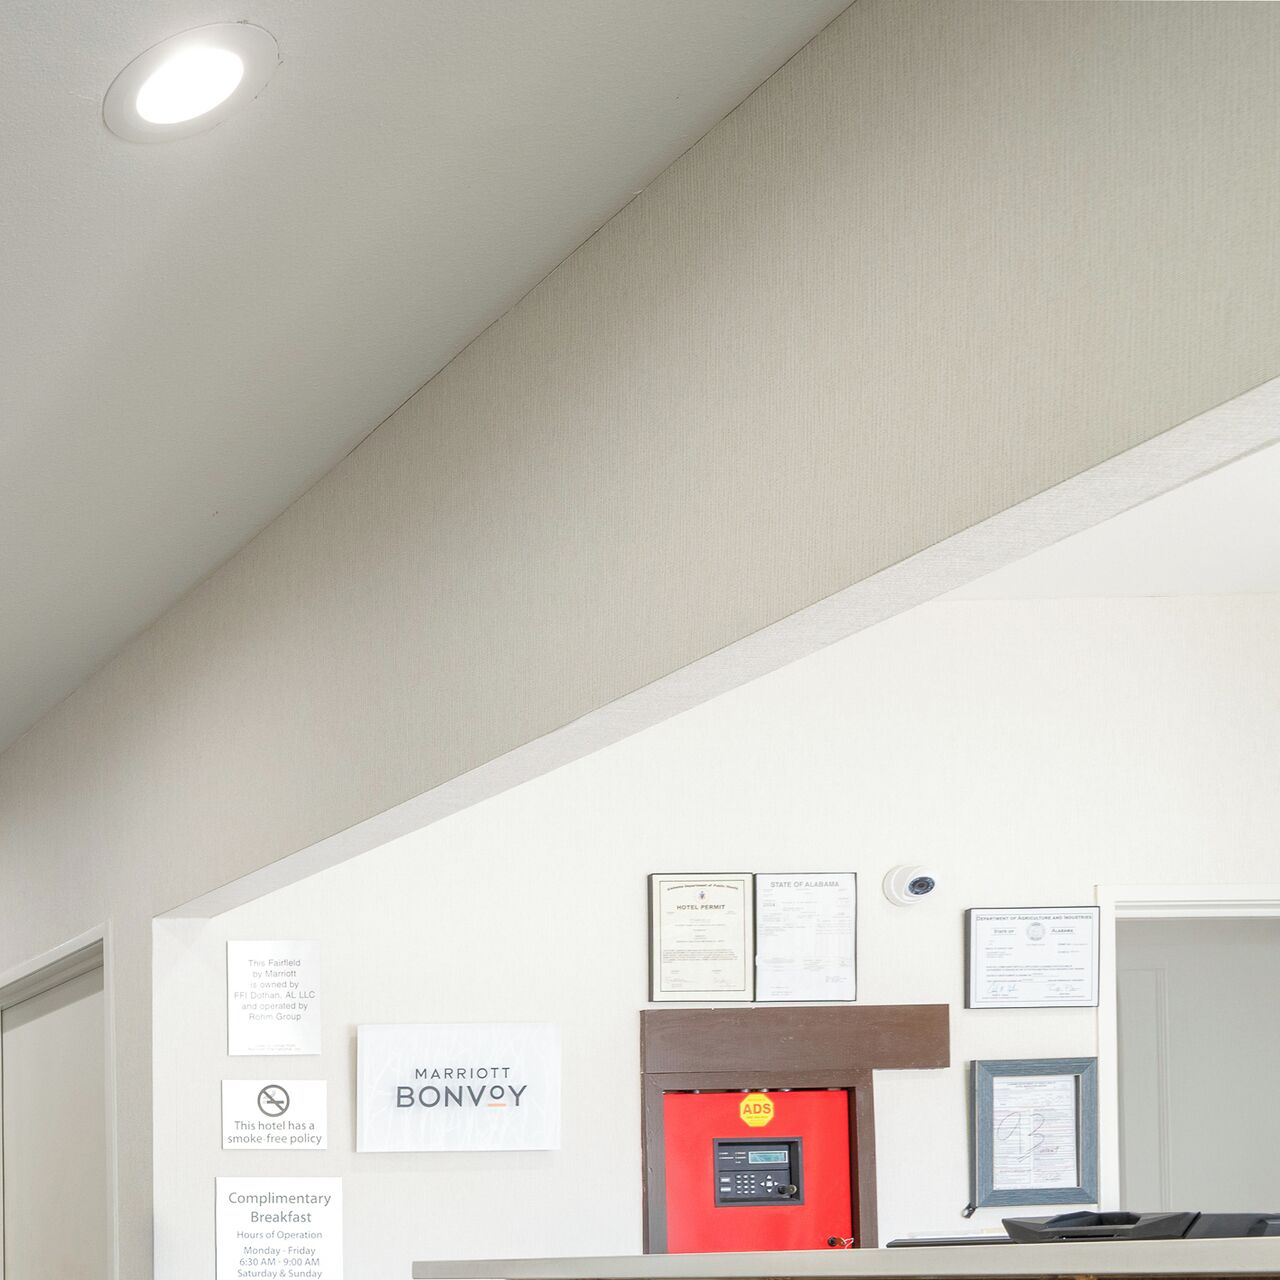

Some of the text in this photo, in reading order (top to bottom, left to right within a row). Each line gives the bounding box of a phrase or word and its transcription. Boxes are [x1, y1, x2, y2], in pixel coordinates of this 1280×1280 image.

[269, 959, 301, 967] Fairfield
[265, 970, 297, 978] Marriott
[290, 981, 300, 990] by
[286, 991, 297, 999] AL
[299, 991, 316, 999] LLC
[259, 1002, 296, 1011] operated
[299, 1002, 308, 1011] by
[276, 1013, 302, 1021] Group
[416, 1067, 511, 1080] MARRIOTT
[397, 1085, 528, 1108] BONVOY
[743, 1104, 772, 1115] ADS
[234, 1121, 315, 1131] This hotel has a
[228, 1133, 322, 1146] smoke-free policy
[229, 1192, 332, 1207] Complimentary
[251, 1211, 312, 1223] Breakfast
[237, 1230, 323, 1240] Hours of Operation
[243, 1246, 281, 1256] Monday
[288, 1246, 316, 1256] Friday
[240, 1258, 258, 1266] 6:30
[261, 1258, 276, 1266] AM
[283, 1258, 302, 1266] 9:00
[304, 1258, 320, 1266] AM
[237, 1269, 323, 1279] Saturday & Sunday
